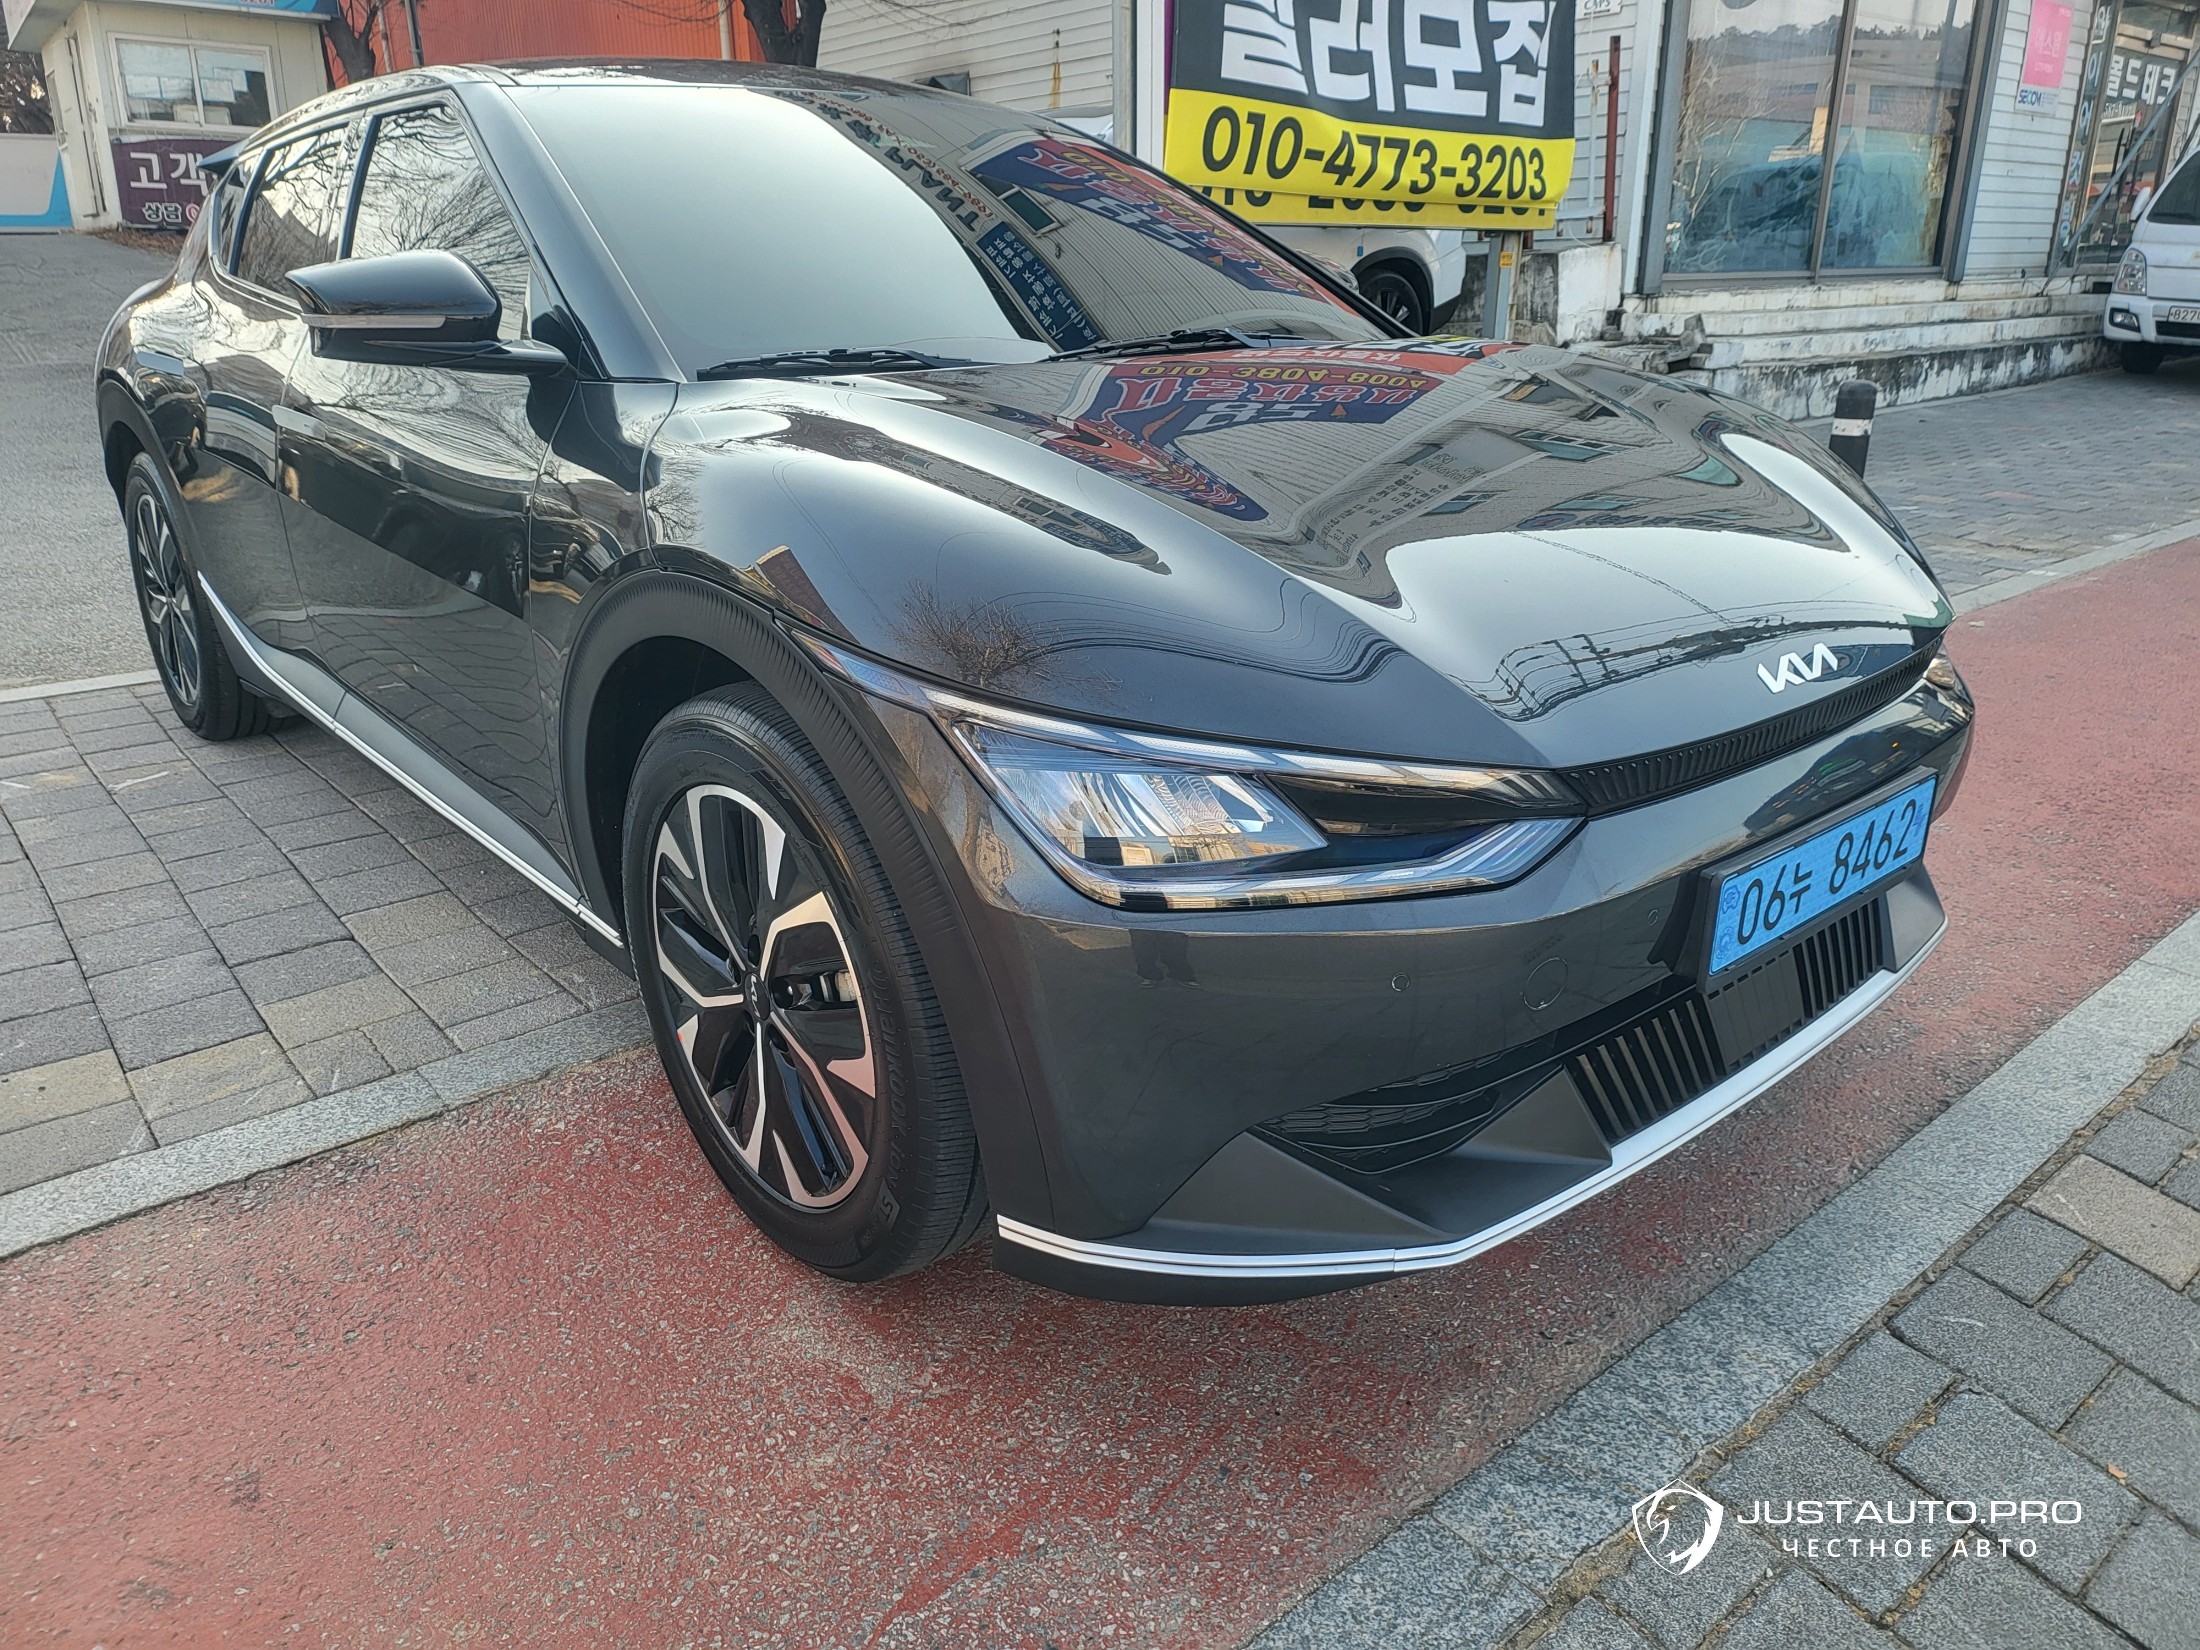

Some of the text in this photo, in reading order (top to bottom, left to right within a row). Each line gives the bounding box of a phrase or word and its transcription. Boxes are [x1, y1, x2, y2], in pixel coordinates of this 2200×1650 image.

[1202, 105, 1547, 201] 010-4773-3203
[142, 202, 182, 223] 상담
[1737, 798, 1917, 945] 06누 8462
